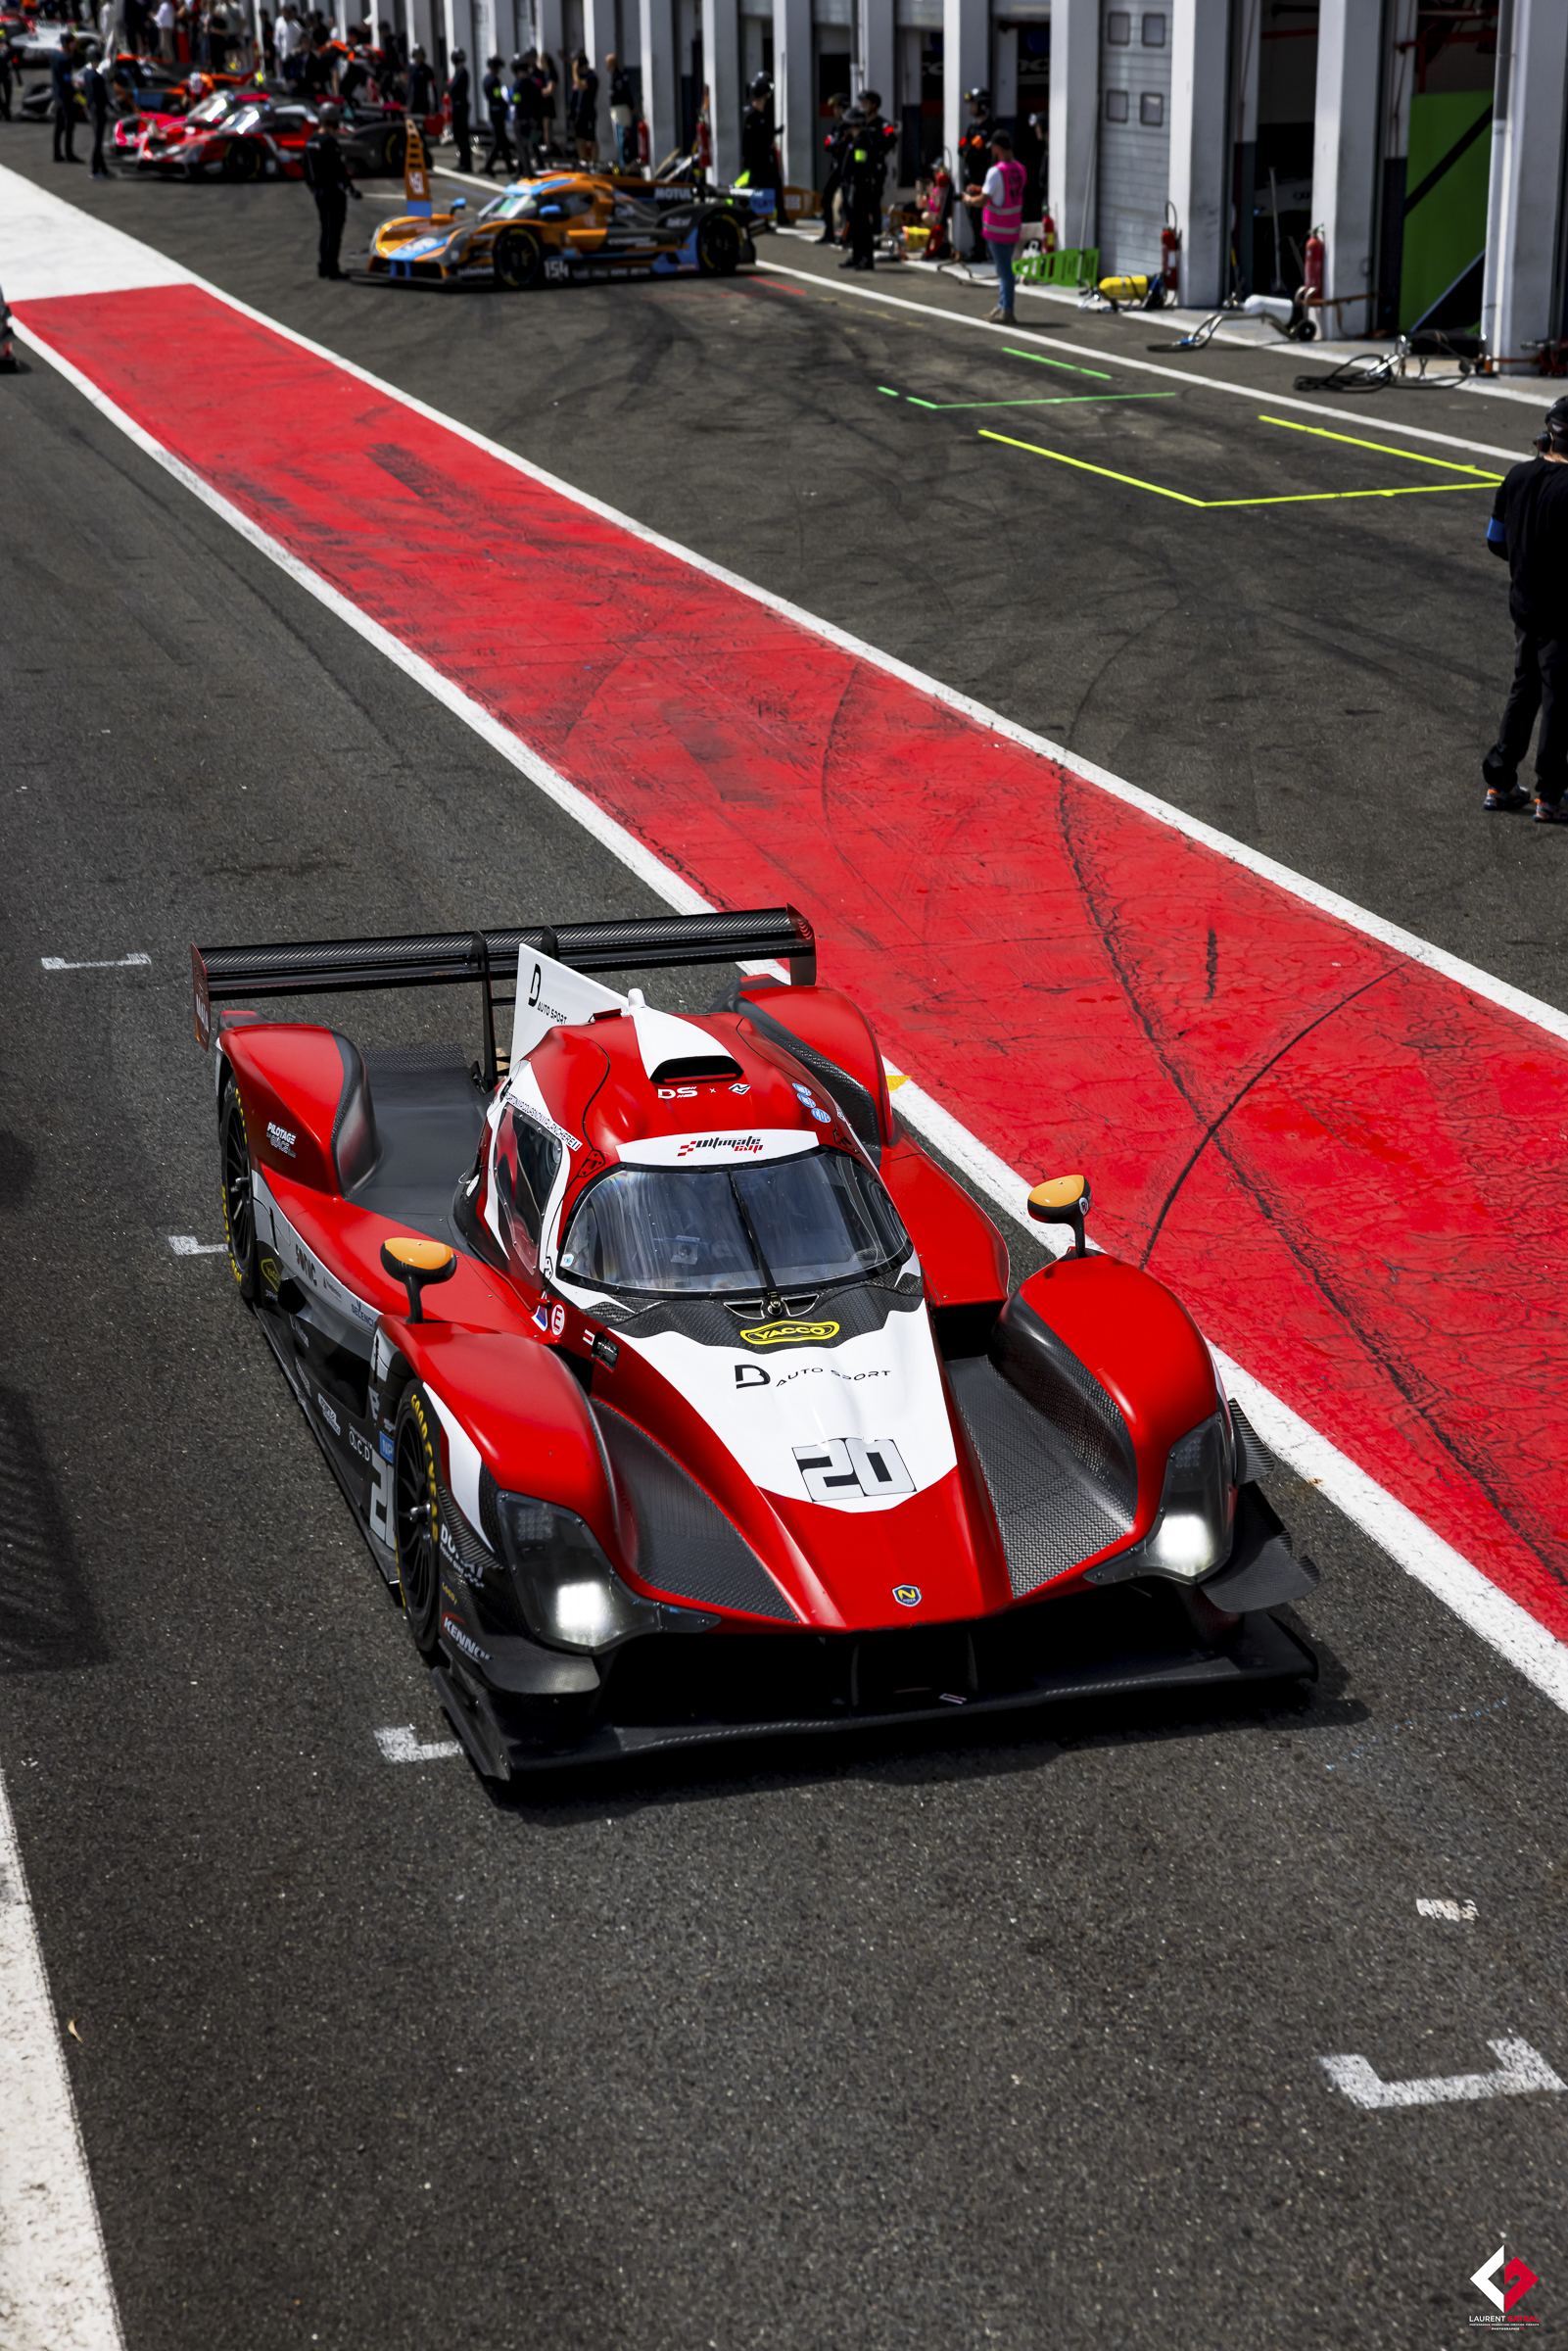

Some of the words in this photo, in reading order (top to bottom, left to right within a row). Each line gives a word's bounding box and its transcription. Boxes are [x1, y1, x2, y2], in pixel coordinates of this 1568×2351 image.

[544, 261, 570, 280] 154
[538, 1000, 550, 1016] AUTO
[550, 1008, 568, 1025] SPORT
[657, 1085, 698, 1100] DS
[266, 1122, 297, 1146] PILOTAGE
[553, 1305, 563, 1330] E
[755, 1326, 826, 1340] YACCO
[776, 1367, 824, 1388] AUTO
[831, 1369, 891, 1382] SPORT
[791, 1436, 918, 1503] 20
